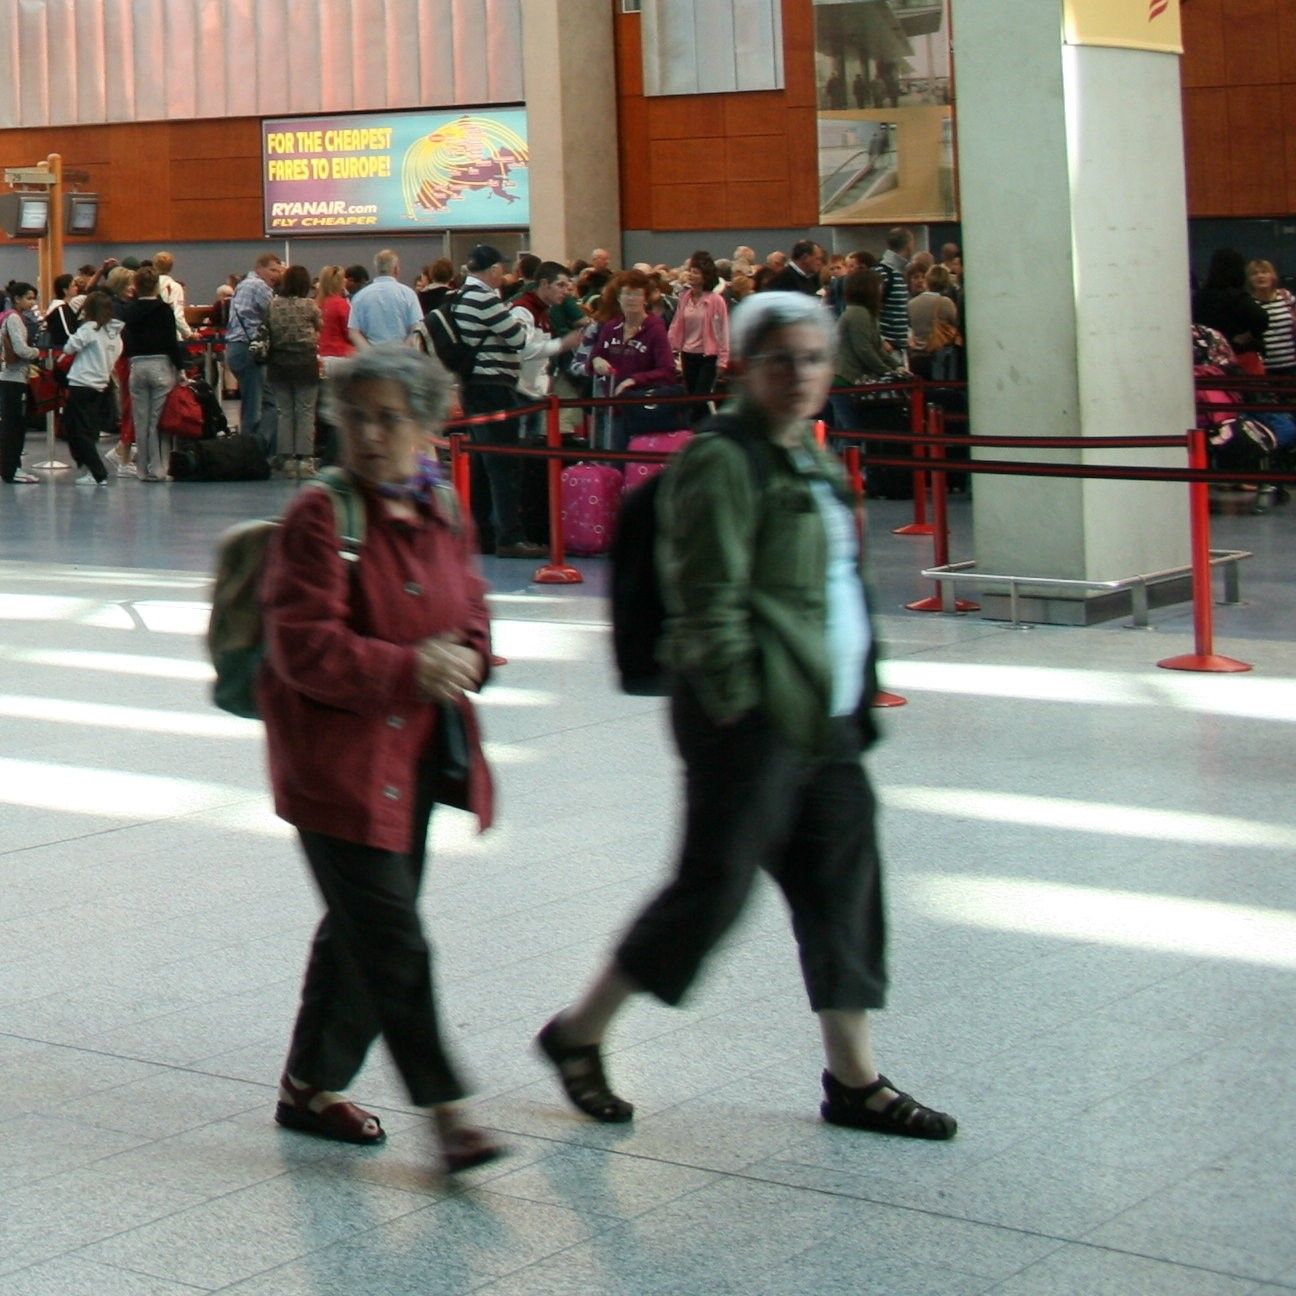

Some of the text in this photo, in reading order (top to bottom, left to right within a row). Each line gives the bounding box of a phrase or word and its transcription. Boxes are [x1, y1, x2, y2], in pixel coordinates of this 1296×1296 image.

[268, 127, 393, 154] FOR THE CHEAPEST
[268, 155, 391, 181] FARES TO EUROPE!
[272, 200, 378, 216] RYANAIR.com
[272, 216, 378, 227] FLY CHEAPER
